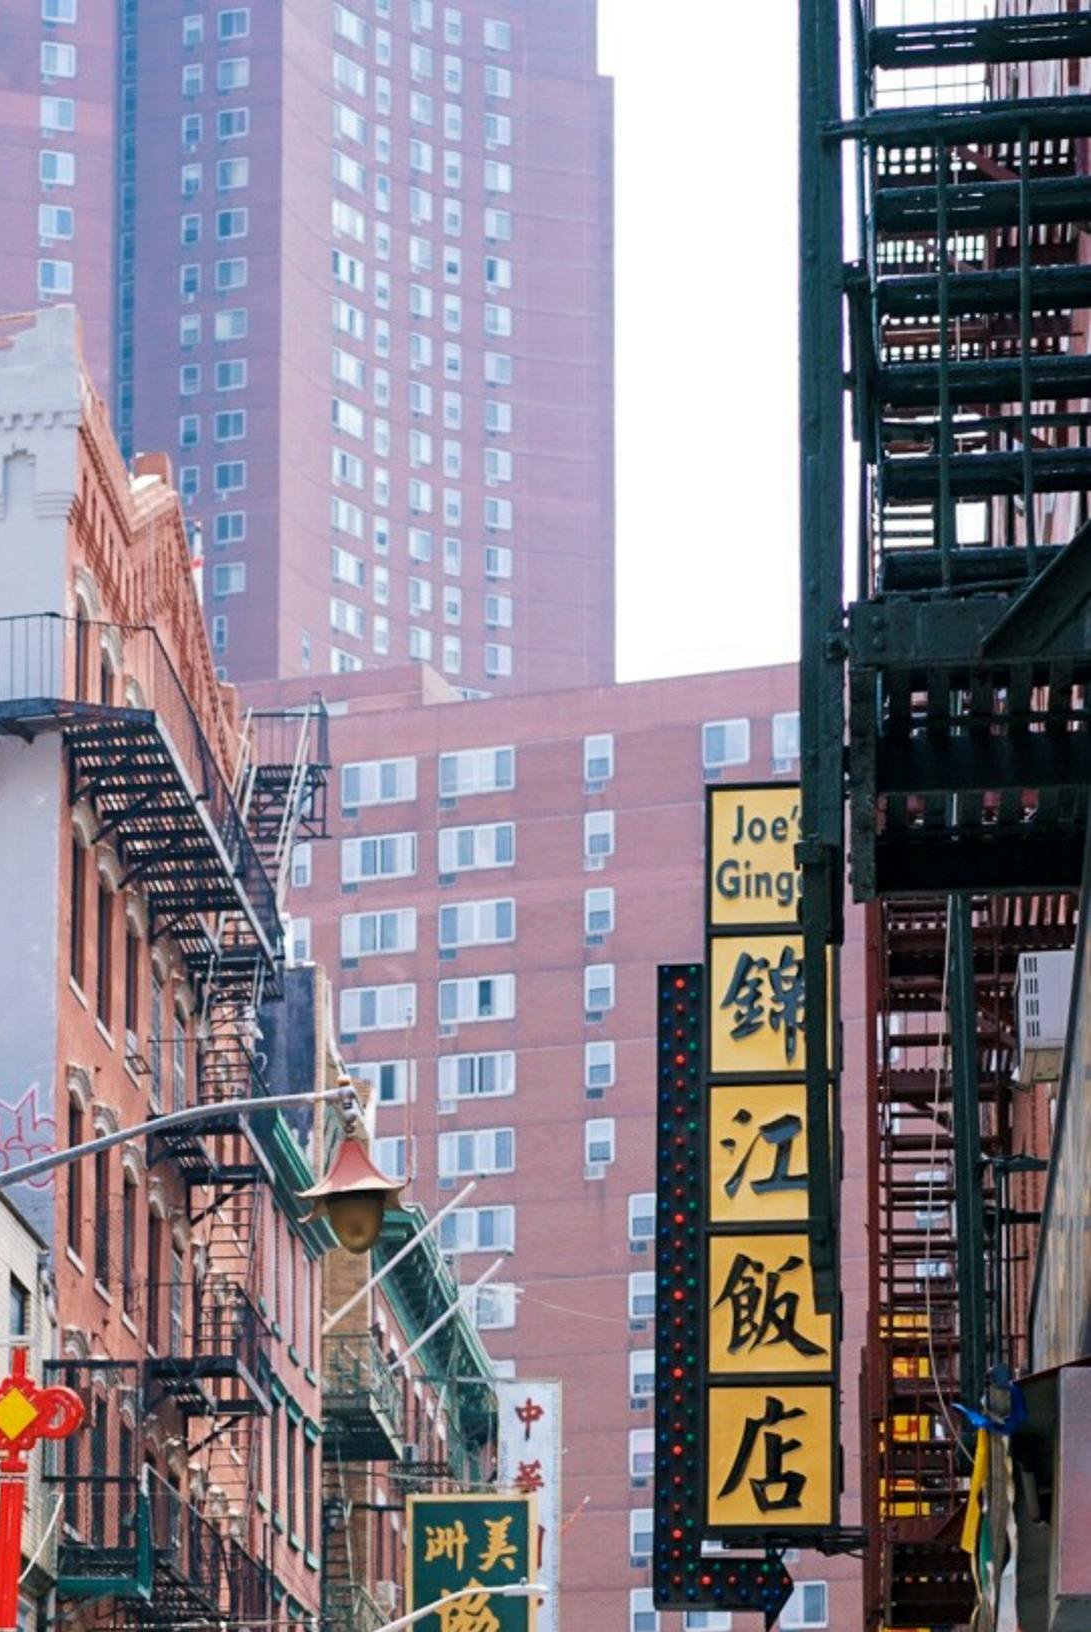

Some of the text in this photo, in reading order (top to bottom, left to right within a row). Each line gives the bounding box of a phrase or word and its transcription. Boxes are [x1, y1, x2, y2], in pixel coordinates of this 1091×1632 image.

[732, 805, 802, 844] Joe'
[716, 859, 802, 908] Ging
[712, 945, 828, 1513] 錦江飯店
